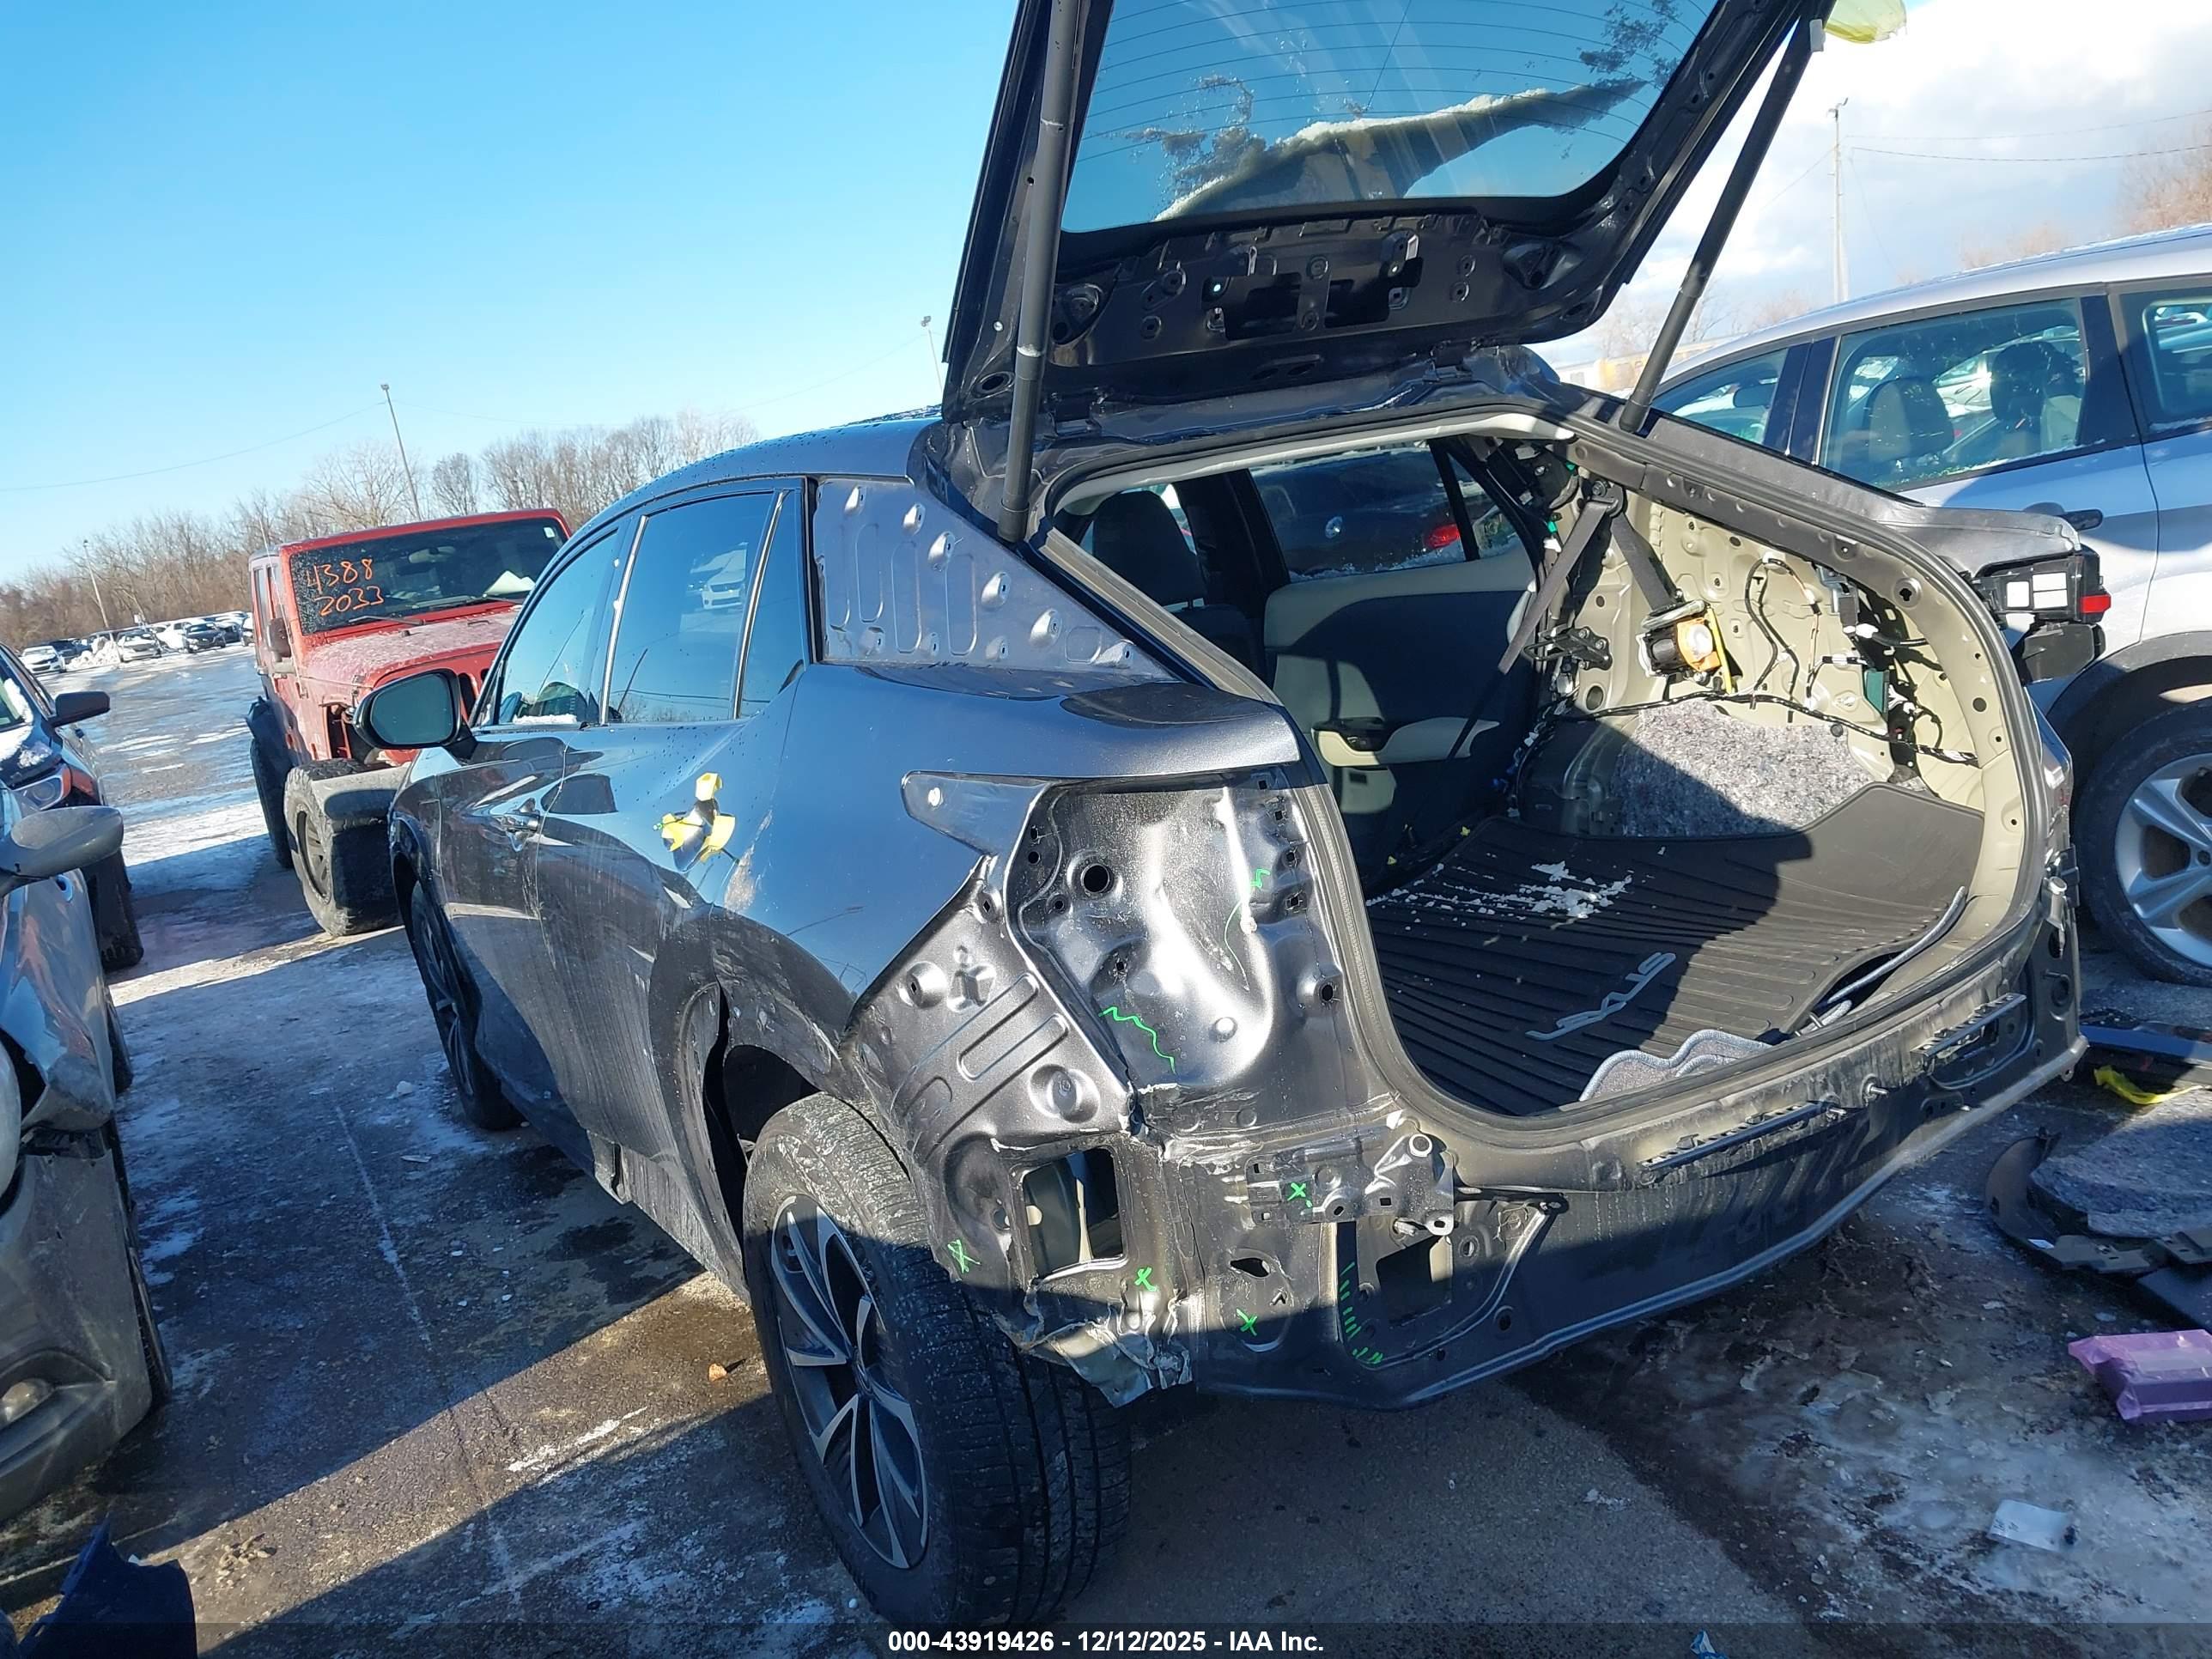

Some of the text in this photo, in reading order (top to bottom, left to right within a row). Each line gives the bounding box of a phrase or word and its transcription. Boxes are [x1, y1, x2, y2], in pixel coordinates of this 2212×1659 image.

[306, 558, 373, 595] 4388
[313, 586, 385, 617] 2033
[1525, 951, 1676, 1042] LEXUS
